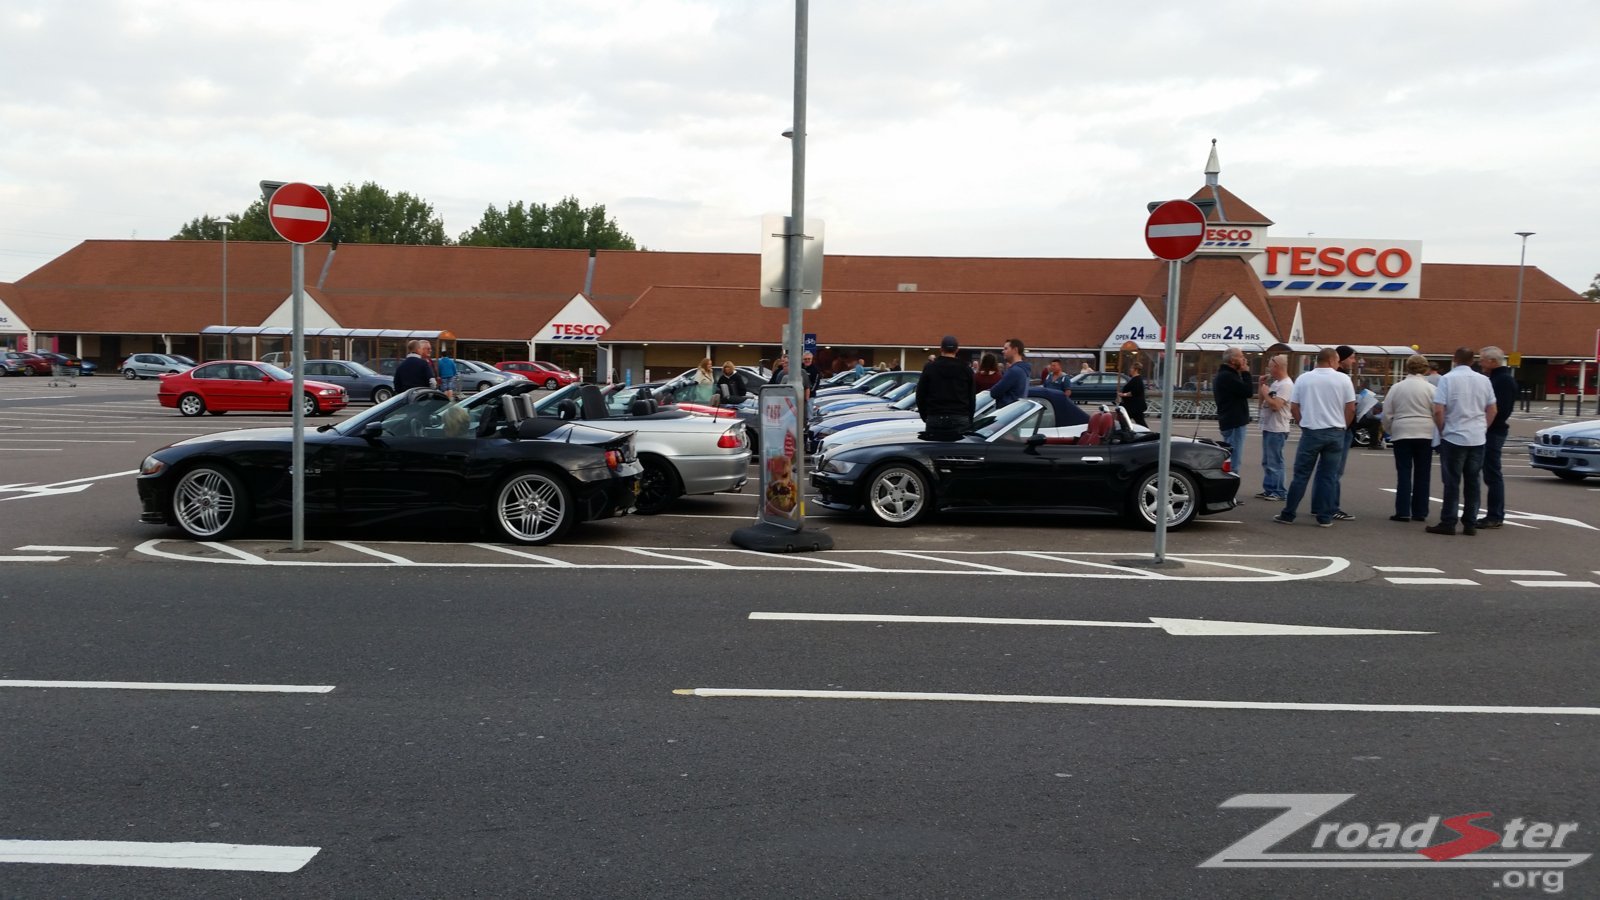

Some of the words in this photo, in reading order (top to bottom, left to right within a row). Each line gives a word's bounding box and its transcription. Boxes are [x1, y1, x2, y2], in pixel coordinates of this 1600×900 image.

[1205, 229, 1253, 241] ESCO
[1265, 246, 1412, 277] TESCO
[552, 324, 606, 335] TESCO
[1130, 326, 1144, 340] 24
[1223, 326, 1243, 340] 24
